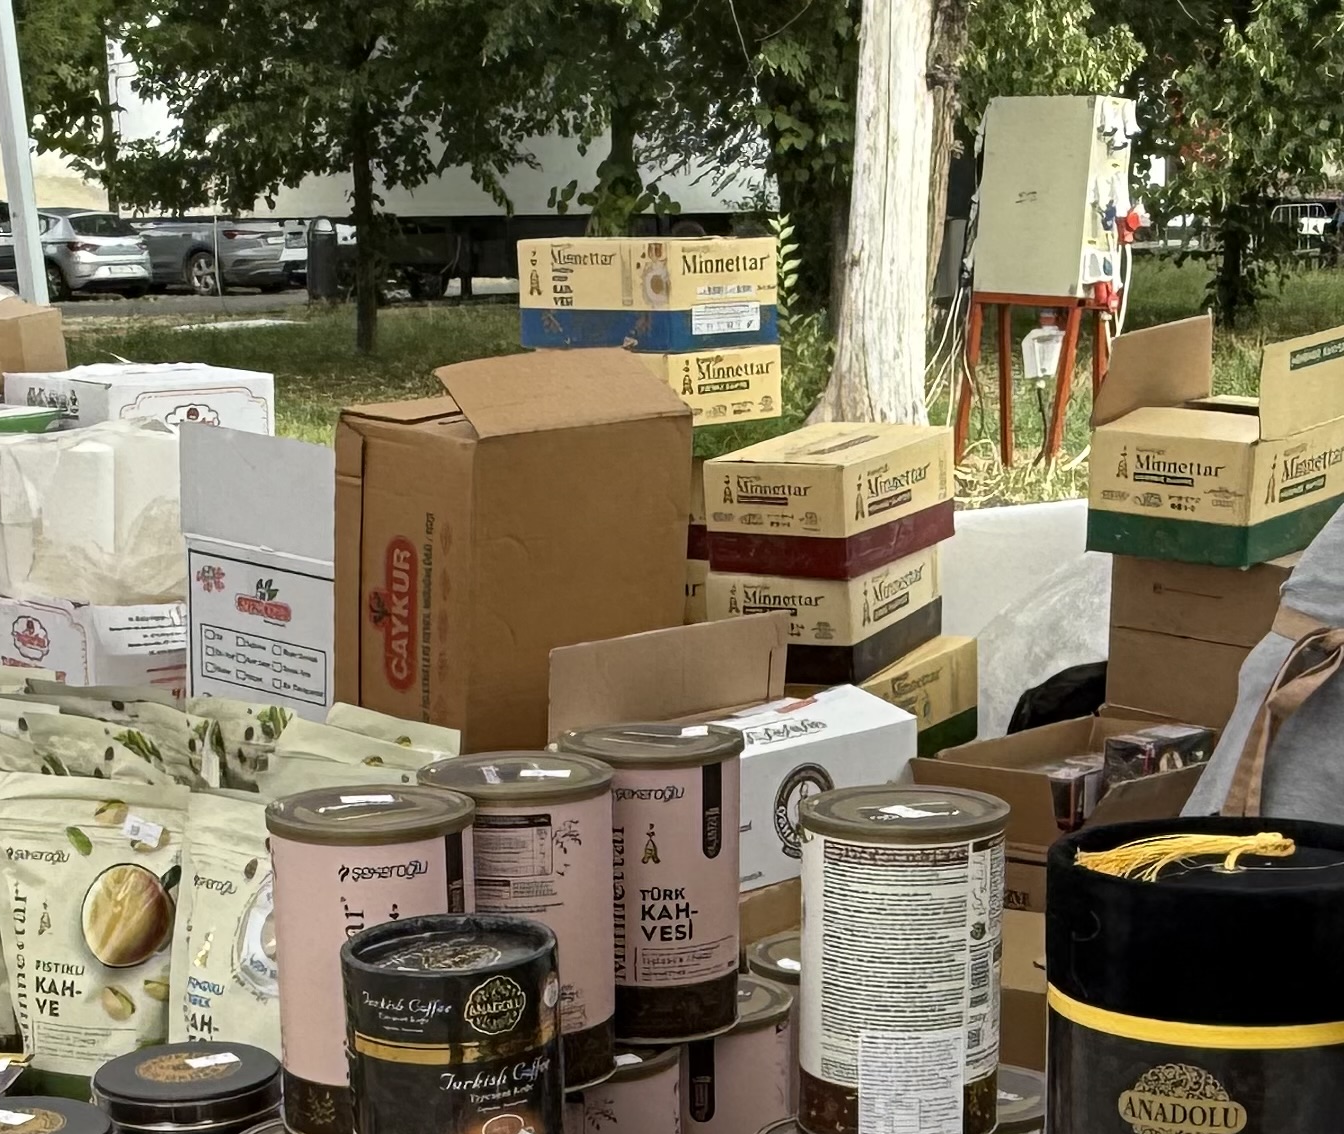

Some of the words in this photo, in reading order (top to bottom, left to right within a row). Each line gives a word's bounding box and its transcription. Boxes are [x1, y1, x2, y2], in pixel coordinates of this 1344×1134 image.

[682, 252, 771, 275] Minnettar
[697, 361, 775, 381] Minnettar
[1134, 453, 1226, 477] Minnettar
[743, 587, 825, 608] Minnettar
[641, 902, 699, 921] KAH-
[35, 977, 82, 997] KAH-
[35, 999, 60, 1018] VE
[1122, 1095, 1242, 1131] ANADOLU
